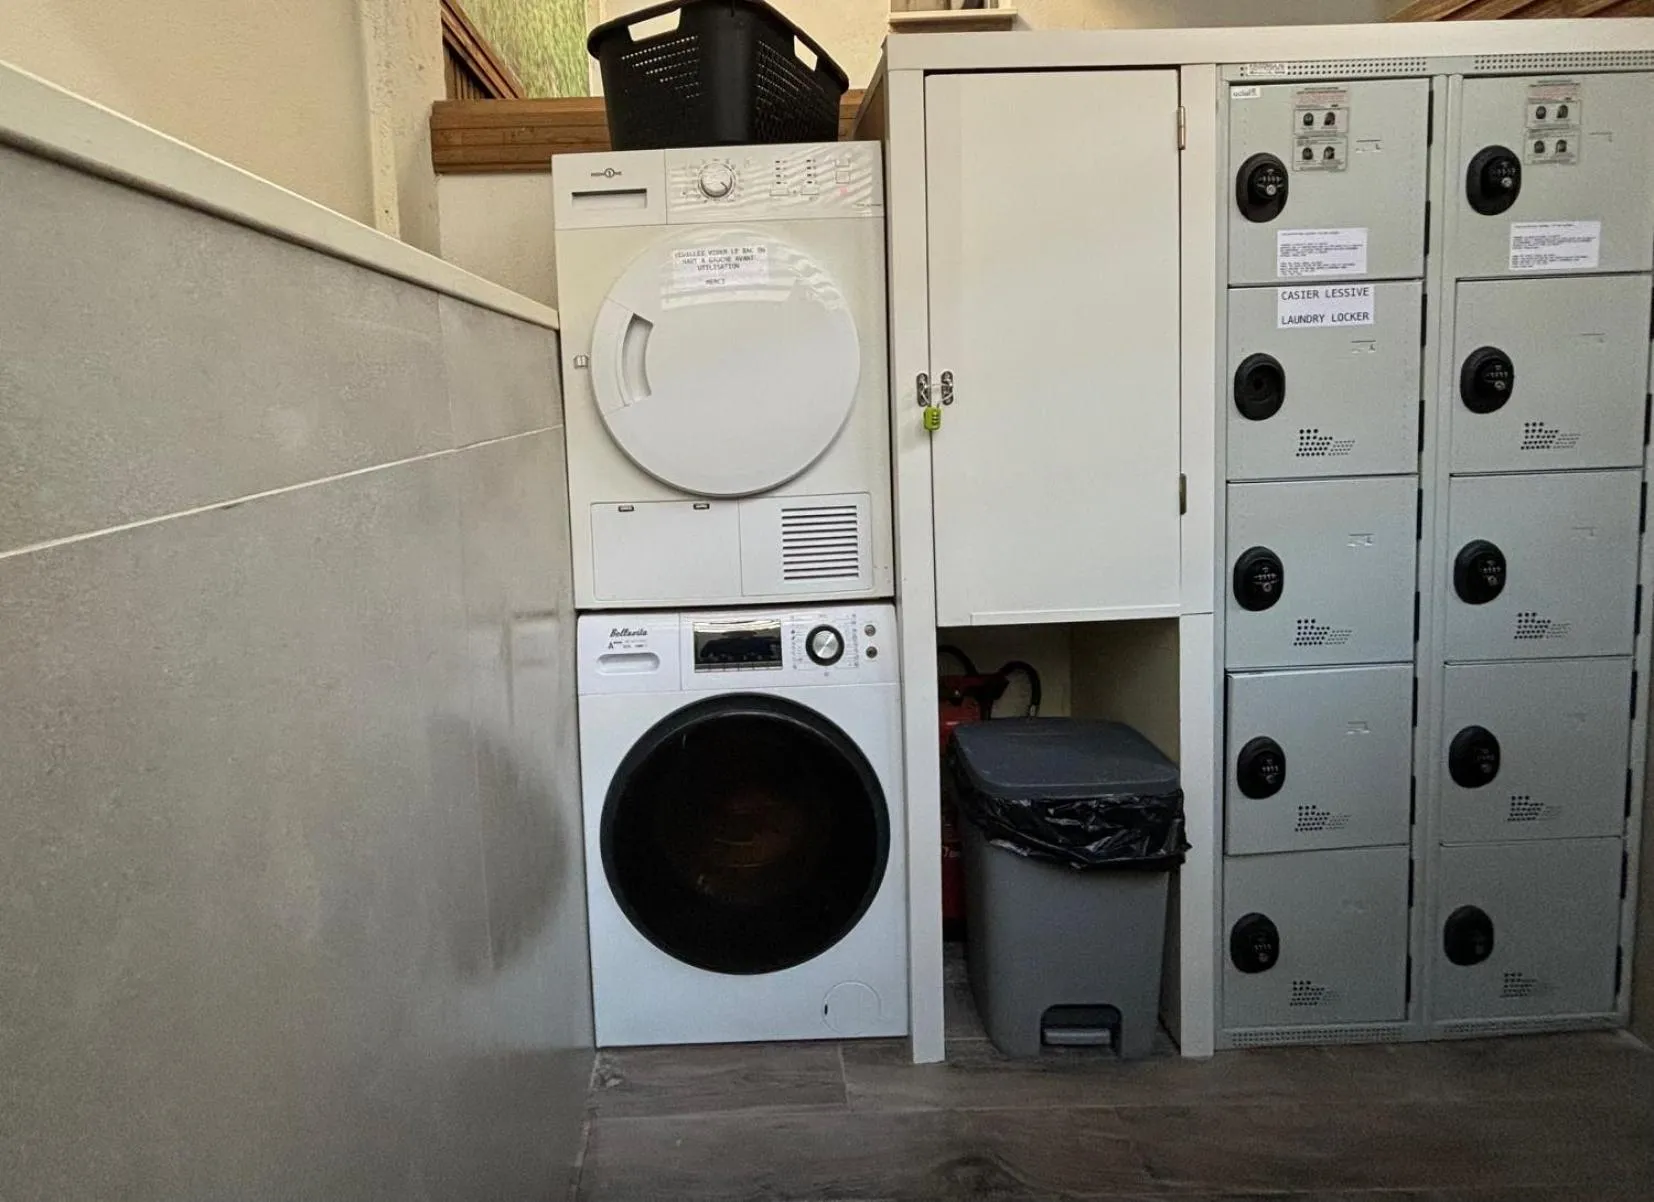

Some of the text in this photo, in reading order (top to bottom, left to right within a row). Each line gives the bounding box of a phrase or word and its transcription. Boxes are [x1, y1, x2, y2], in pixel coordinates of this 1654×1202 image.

[735, 254, 754, 262] AVANT
[697, 263, 740, 271] UTILISATION
[1281, 287, 1370, 301] CASIER LESSIVE
[1281, 311, 1370, 325] LAUNDRY LOCKER
